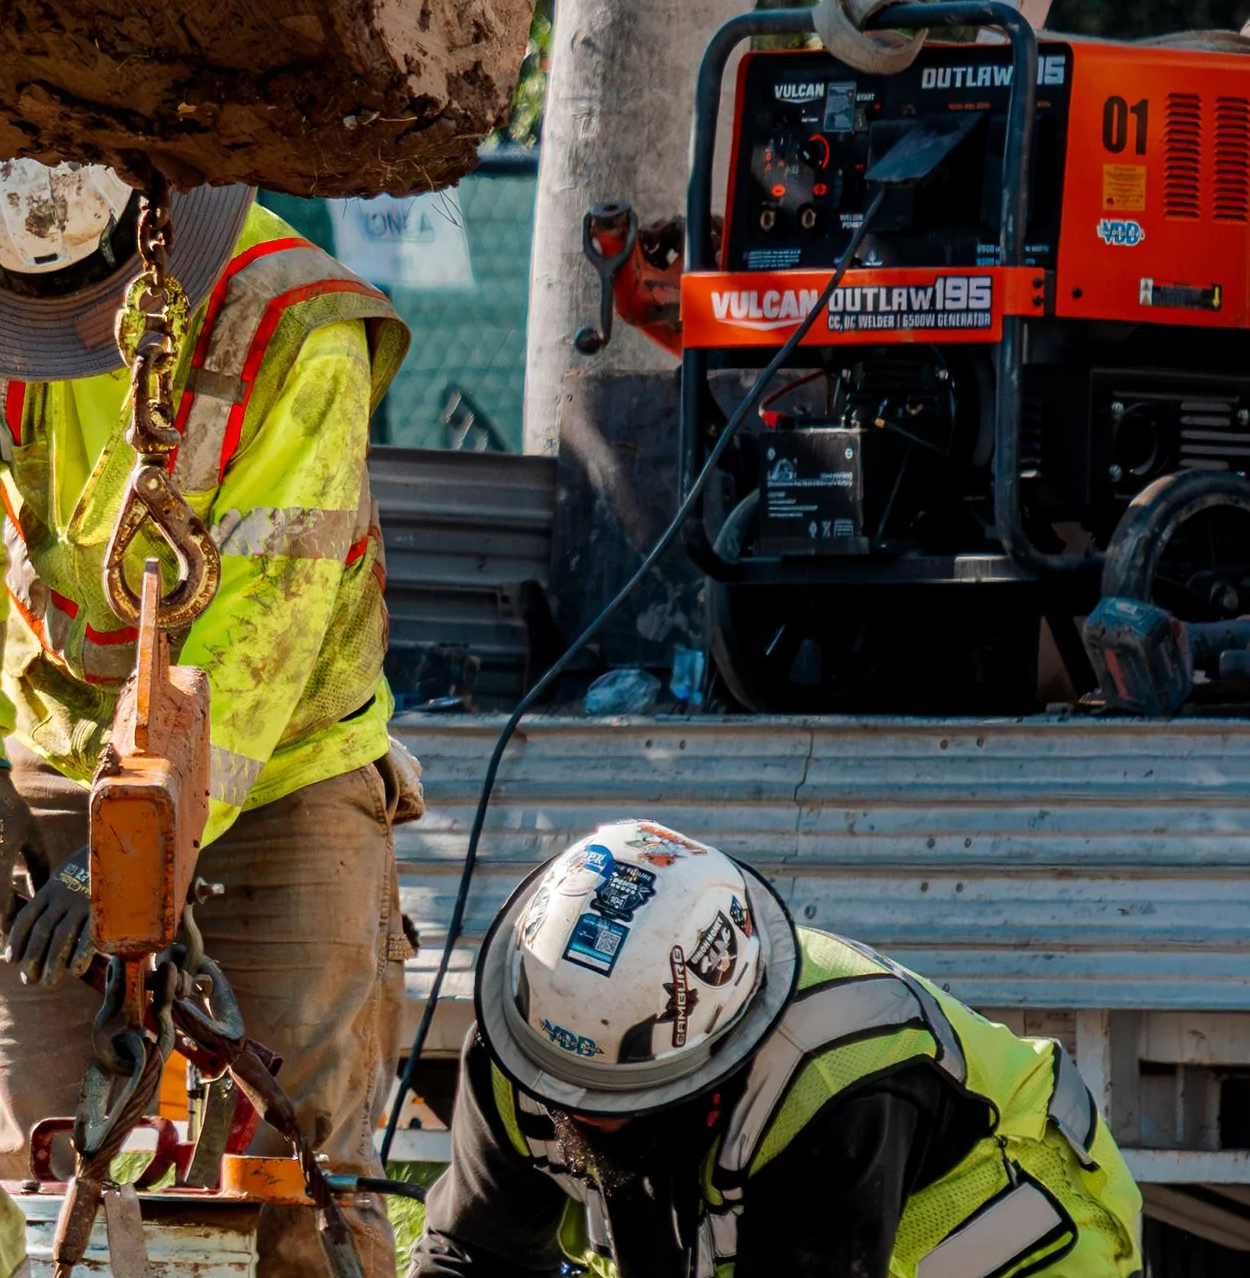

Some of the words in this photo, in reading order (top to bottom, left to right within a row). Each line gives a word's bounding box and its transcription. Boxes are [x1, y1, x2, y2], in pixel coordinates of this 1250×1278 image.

[921, 65, 1014, 89] OUTLAW
[774, 82, 825, 99] VULCAN
[1102, 95, 1149, 156] 01
[711, 289, 819, 320] VULCAN
[858, 314, 895, 329] WELDER
[937, 312, 991, 327] GENERATOR
[689, 938, 710, 965] UNION
